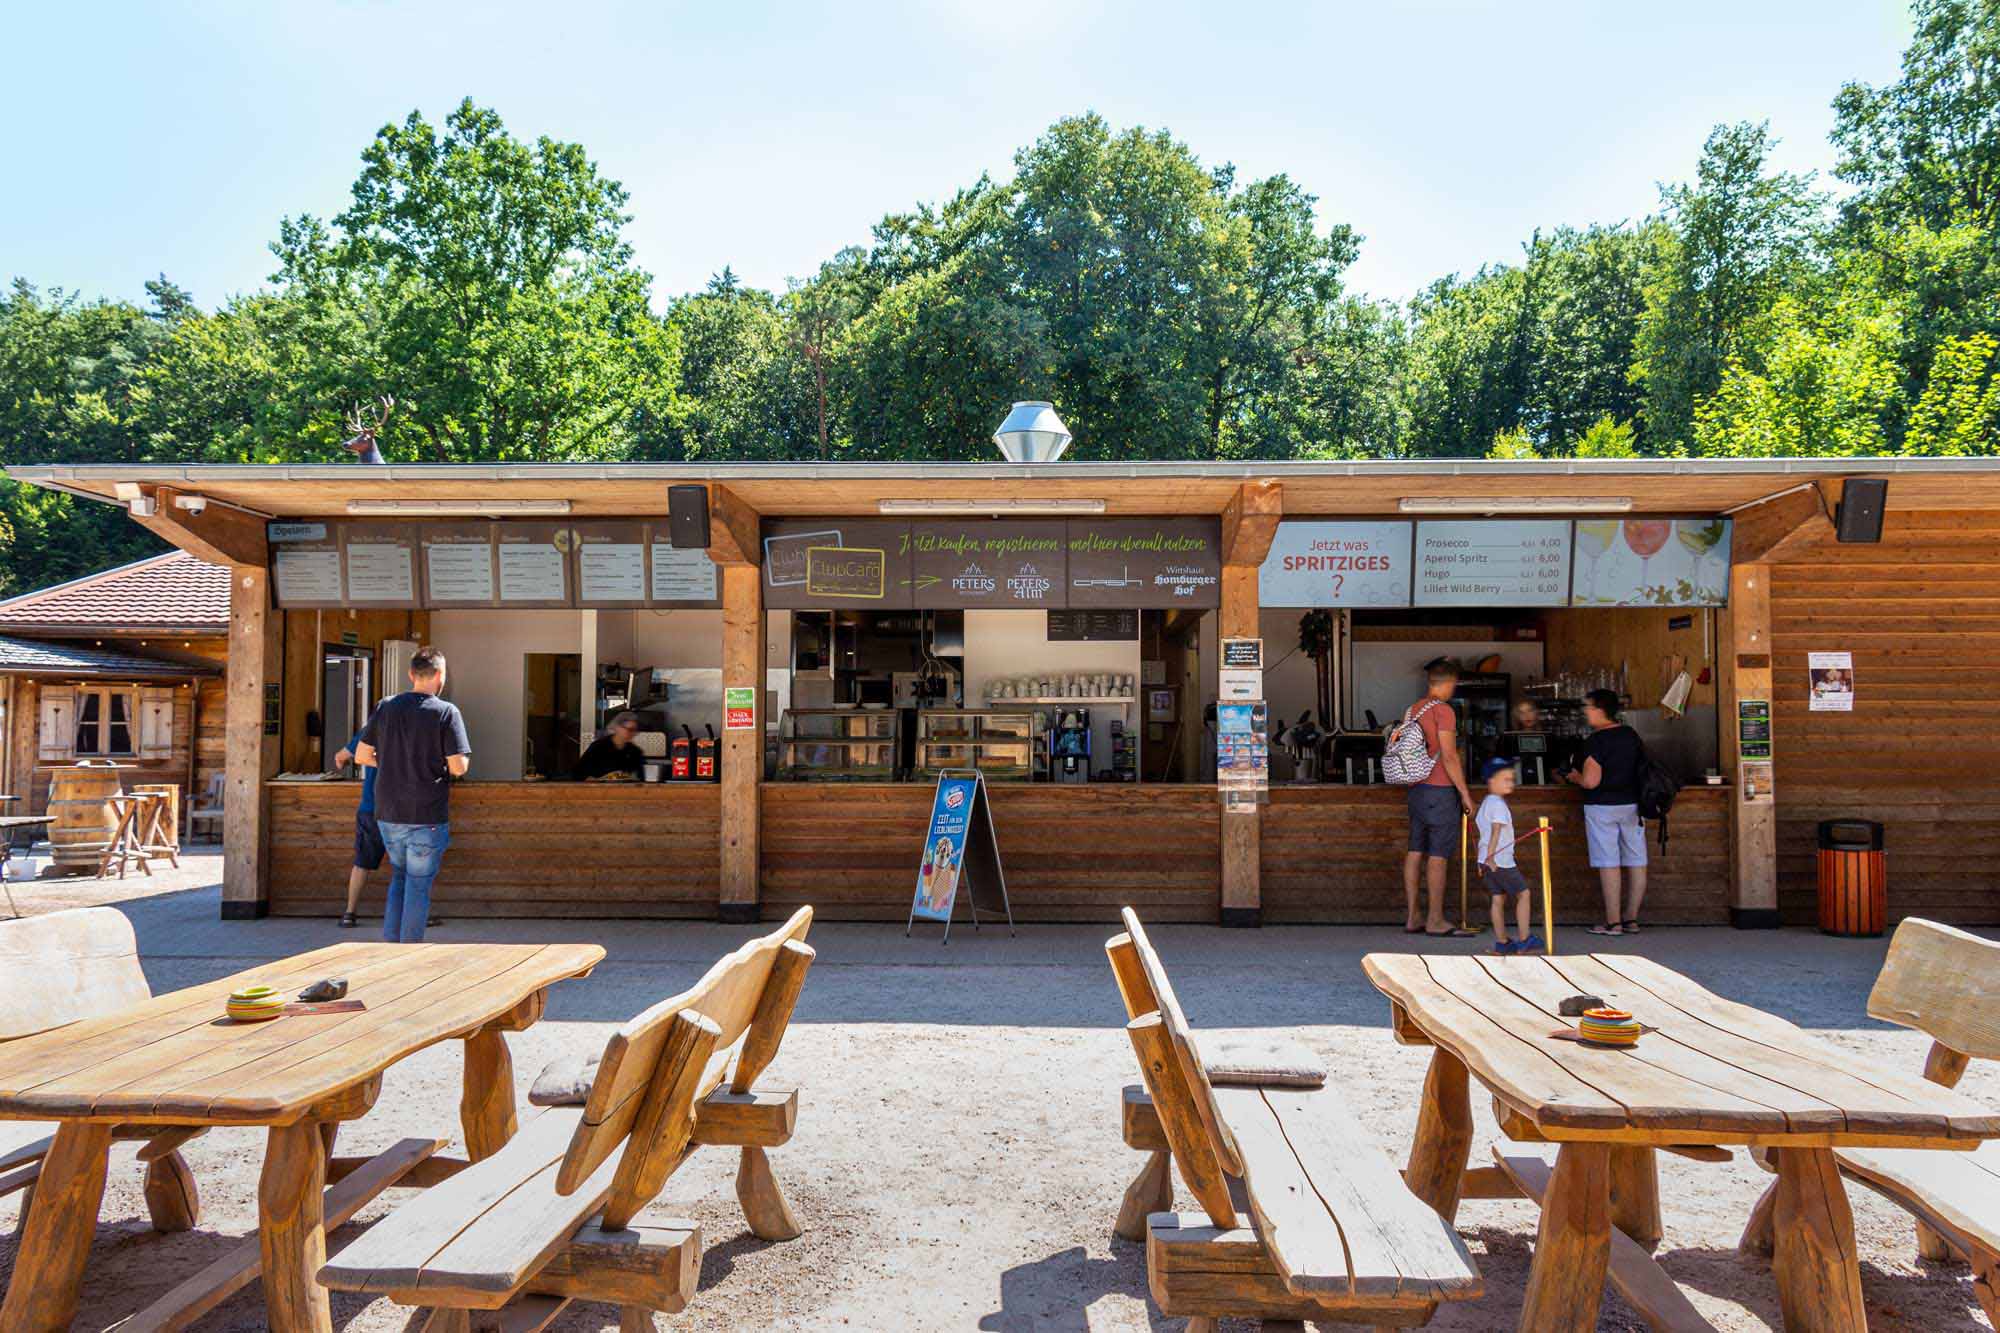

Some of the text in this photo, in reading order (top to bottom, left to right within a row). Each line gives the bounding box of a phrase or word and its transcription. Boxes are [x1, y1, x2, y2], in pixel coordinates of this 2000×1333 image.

[1309, 539, 1369, 551] Jetzt was
[1425, 538, 1470, 548] Prosecco
[1539, 538, 1561, 549] 4,00
[1424, 554, 1457, 564] Aperol
[1458, 553, 1489, 565] Spritz
[1424, 570, 1450, 580] Hugo
[952, 578, 996, 592] PETERS
[1007, 578, 1050, 592] PETERS
[1331, 574, 1345, 599] ?
[1424, 585, 1448, 593] Lillet
[1450, 584, 1473, 593] Wild
[1473, 584, 1501, 595] Berry
[1537, 584, 1559, 594] 6,00
[1014, 586, 1043, 600] Alm
